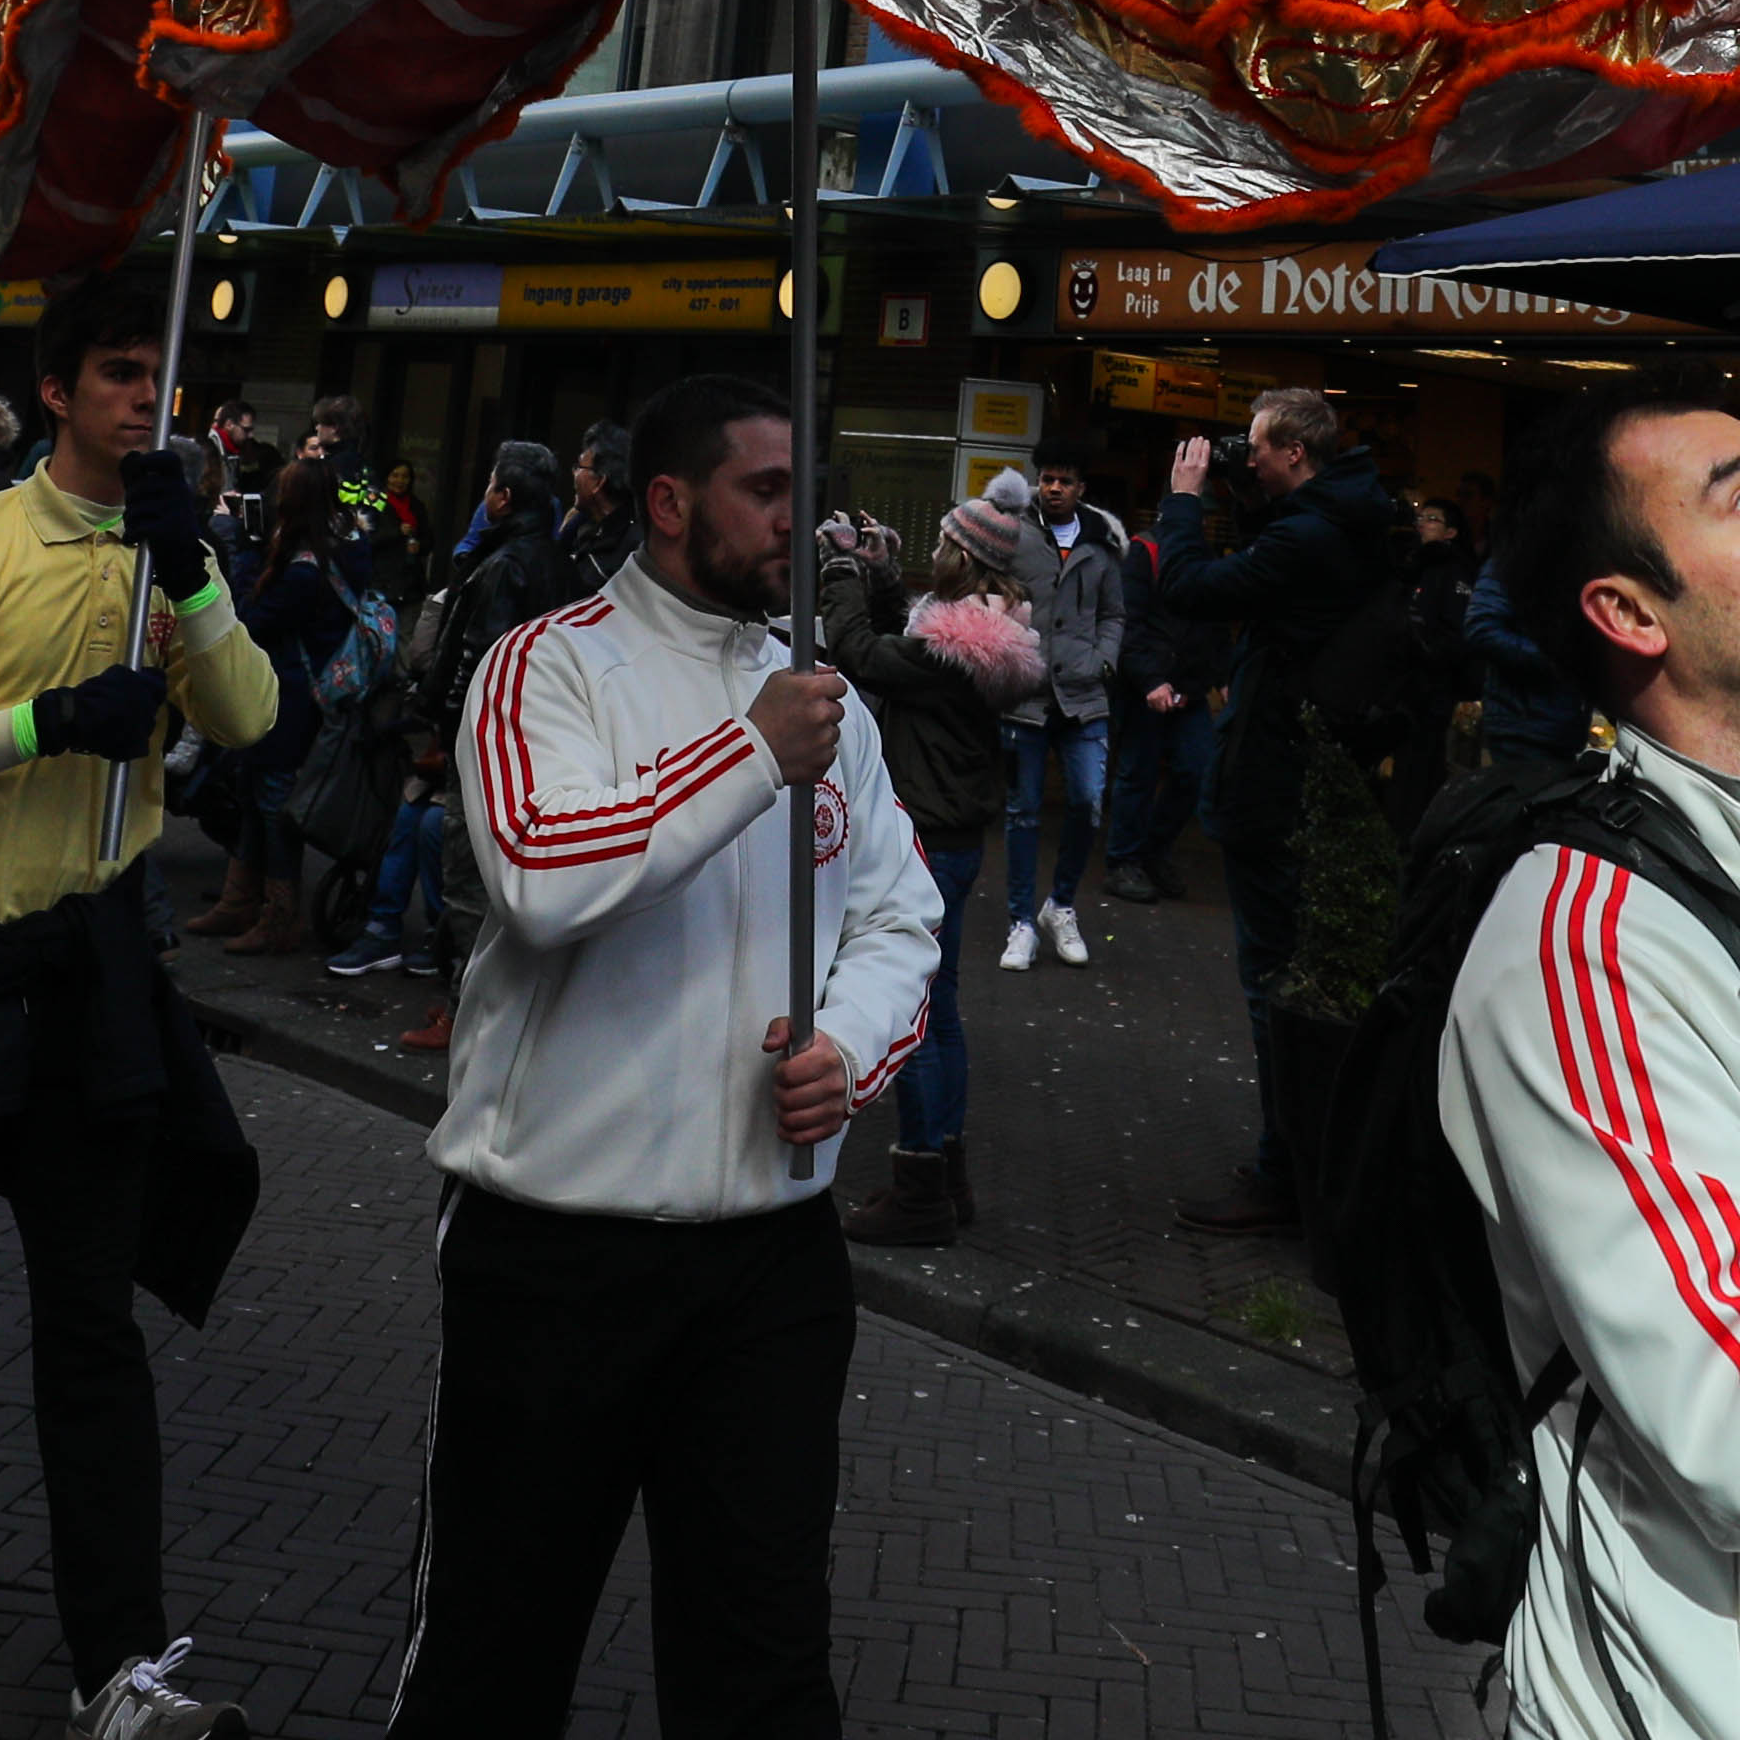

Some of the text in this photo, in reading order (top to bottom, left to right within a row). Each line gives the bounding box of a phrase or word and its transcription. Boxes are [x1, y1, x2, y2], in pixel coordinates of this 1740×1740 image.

[662, 274, 774, 292] city appartementen
[1117, 261, 1172, 287] Laag in
[523, 283, 632, 307] ingang garage
[1187, 262, 1244, 314] de
[689, 297, 710, 311] 437
[1124, 291, 1161, 319] Prijs
[899, 307, 910, 331] B
